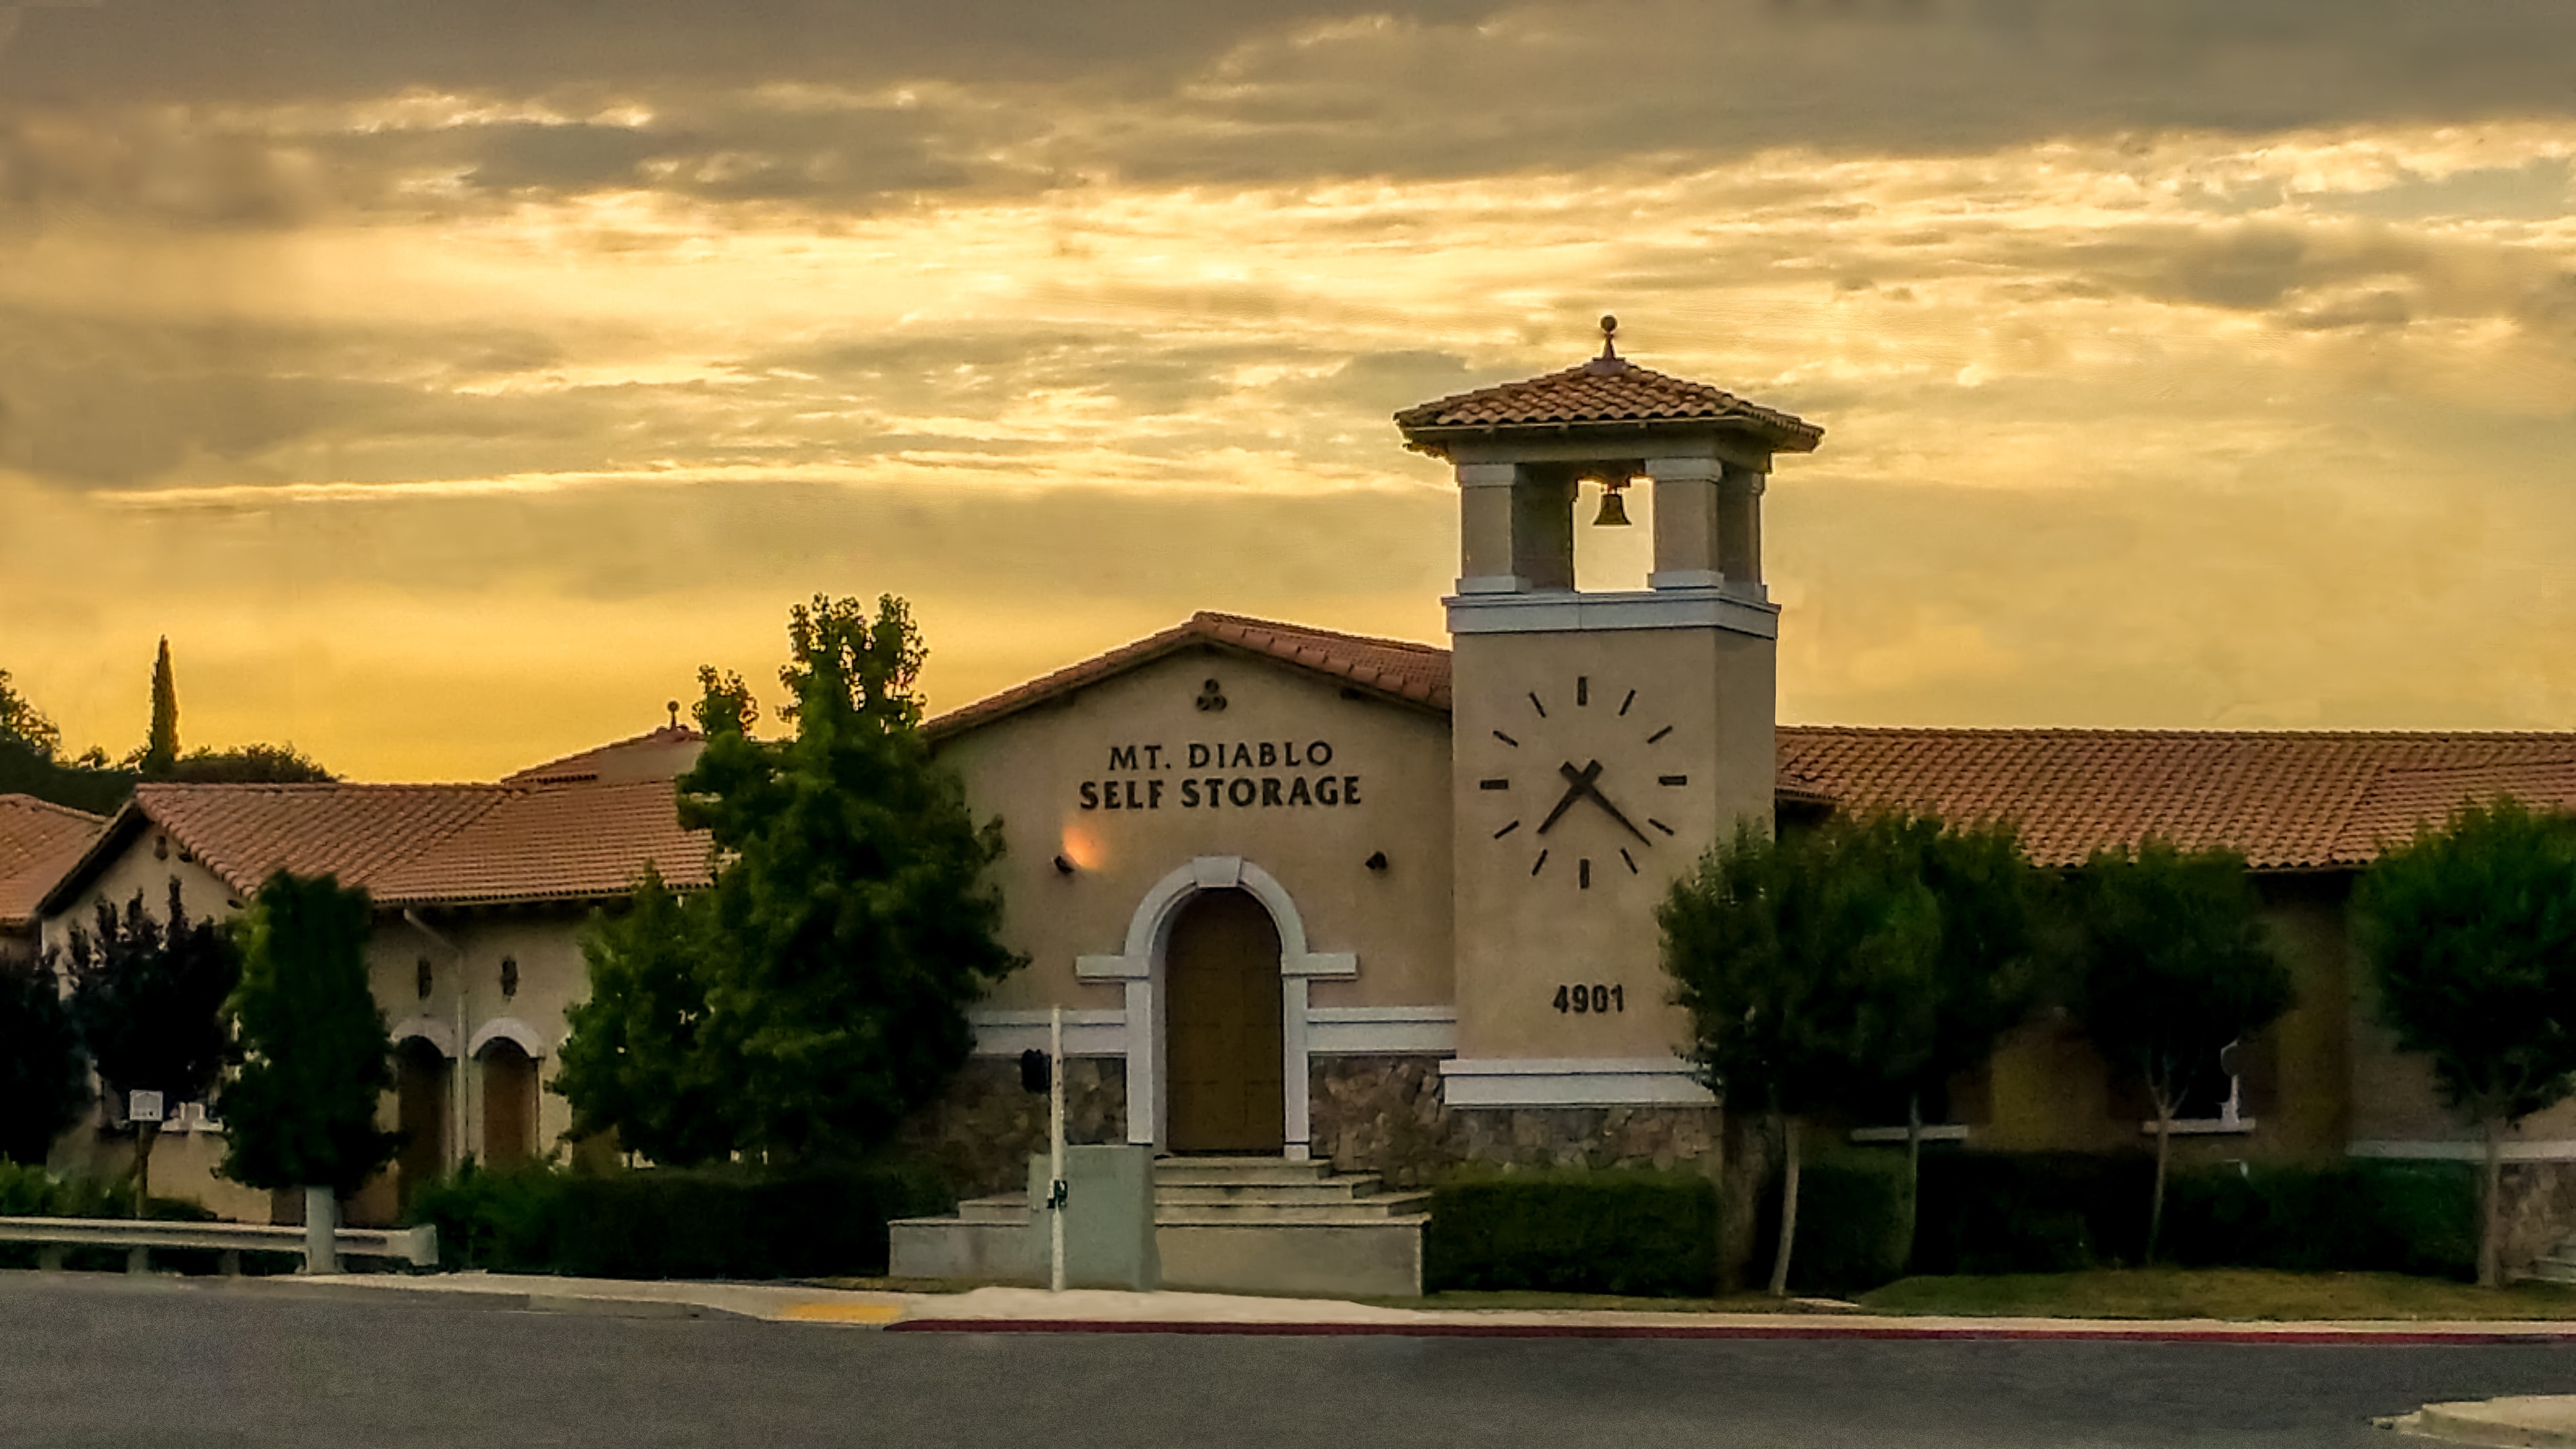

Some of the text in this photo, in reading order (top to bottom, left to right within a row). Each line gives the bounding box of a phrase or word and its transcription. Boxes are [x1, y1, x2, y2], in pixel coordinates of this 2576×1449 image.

[1109, 741, 1334, 771] MT. DIABLO
[1079, 776, 1361, 810] SELF STORAGE
[1553, 983, 1623, 1014] 4901
